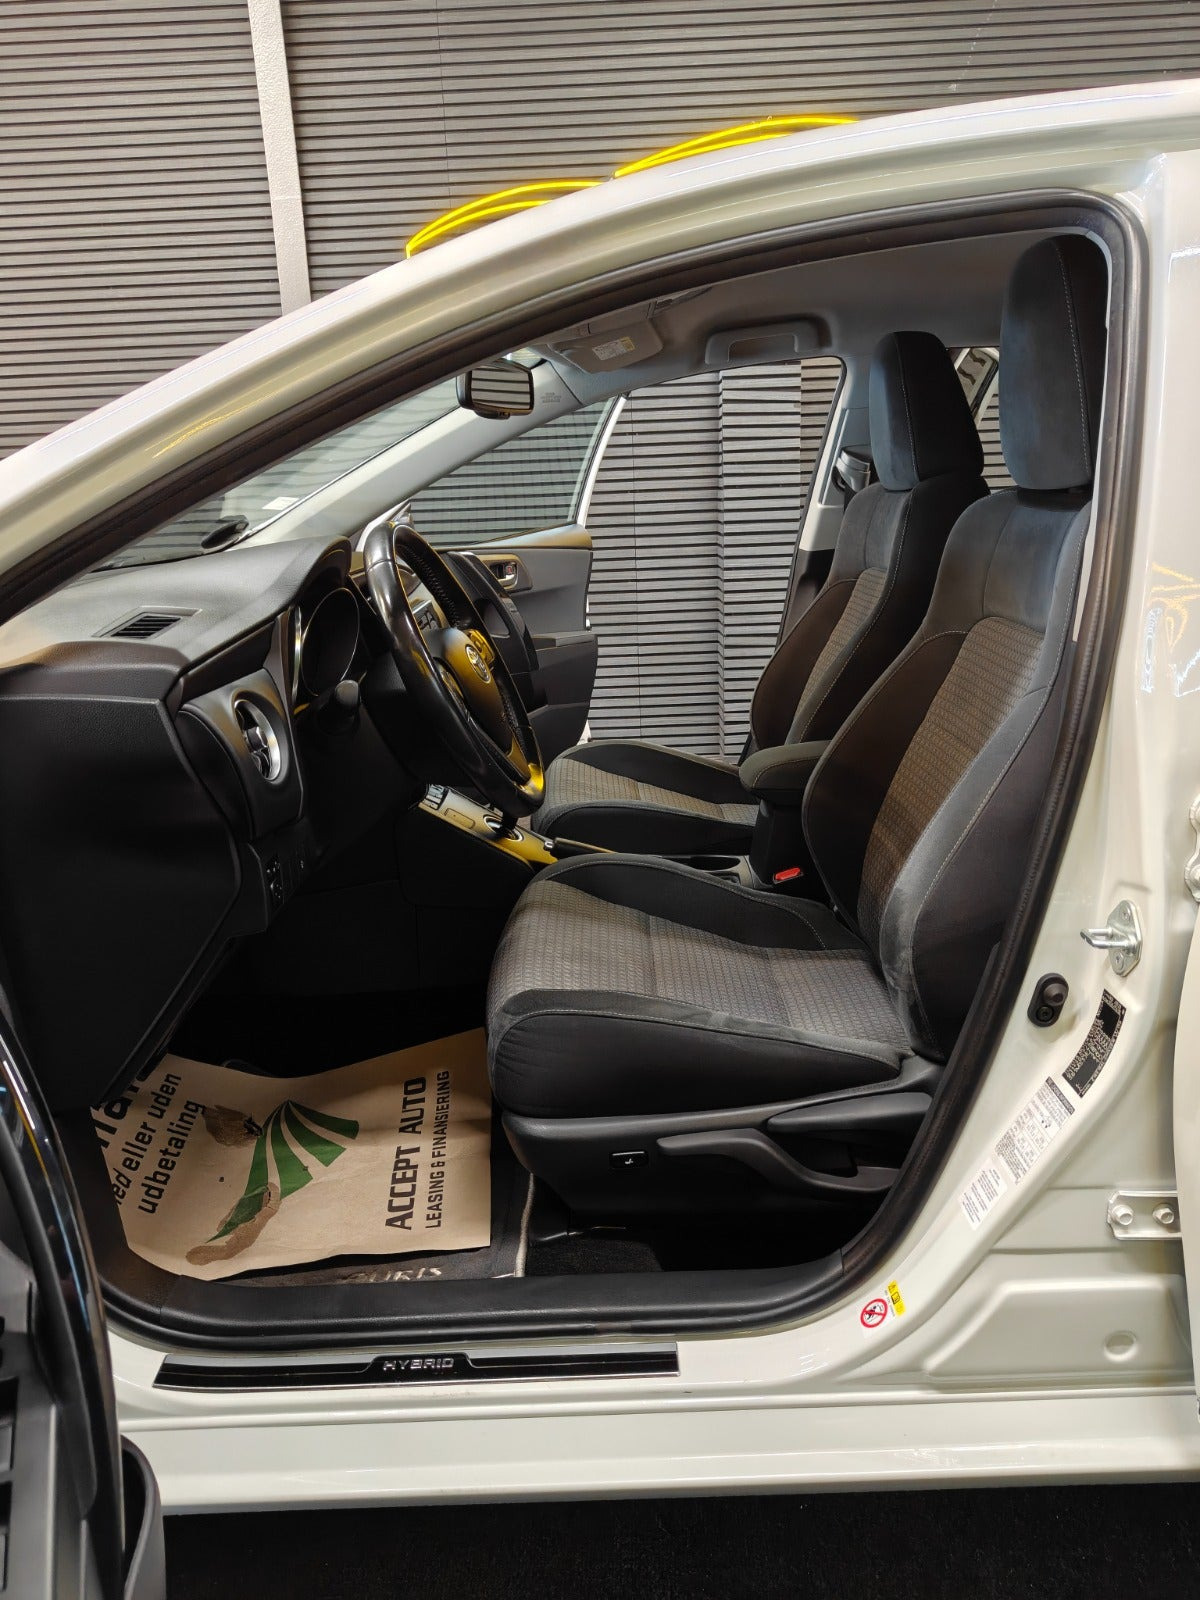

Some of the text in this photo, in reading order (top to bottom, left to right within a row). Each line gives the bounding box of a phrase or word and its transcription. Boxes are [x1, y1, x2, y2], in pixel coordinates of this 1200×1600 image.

[147, 1073, 181, 1119] uden
[431, 1070, 450, 1158] FINANSIERING
[121, 1121, 156, 1172] eller
[138, 1100, 206, 1214] udbetaling
[385, 1076, 427, 1230] ACCEPT AUTO
[111, 1167, 132, 1205] ed
[425, 1171, 445, 1229] LEASING
[383, 1357, 454, 1371] HYBRID
